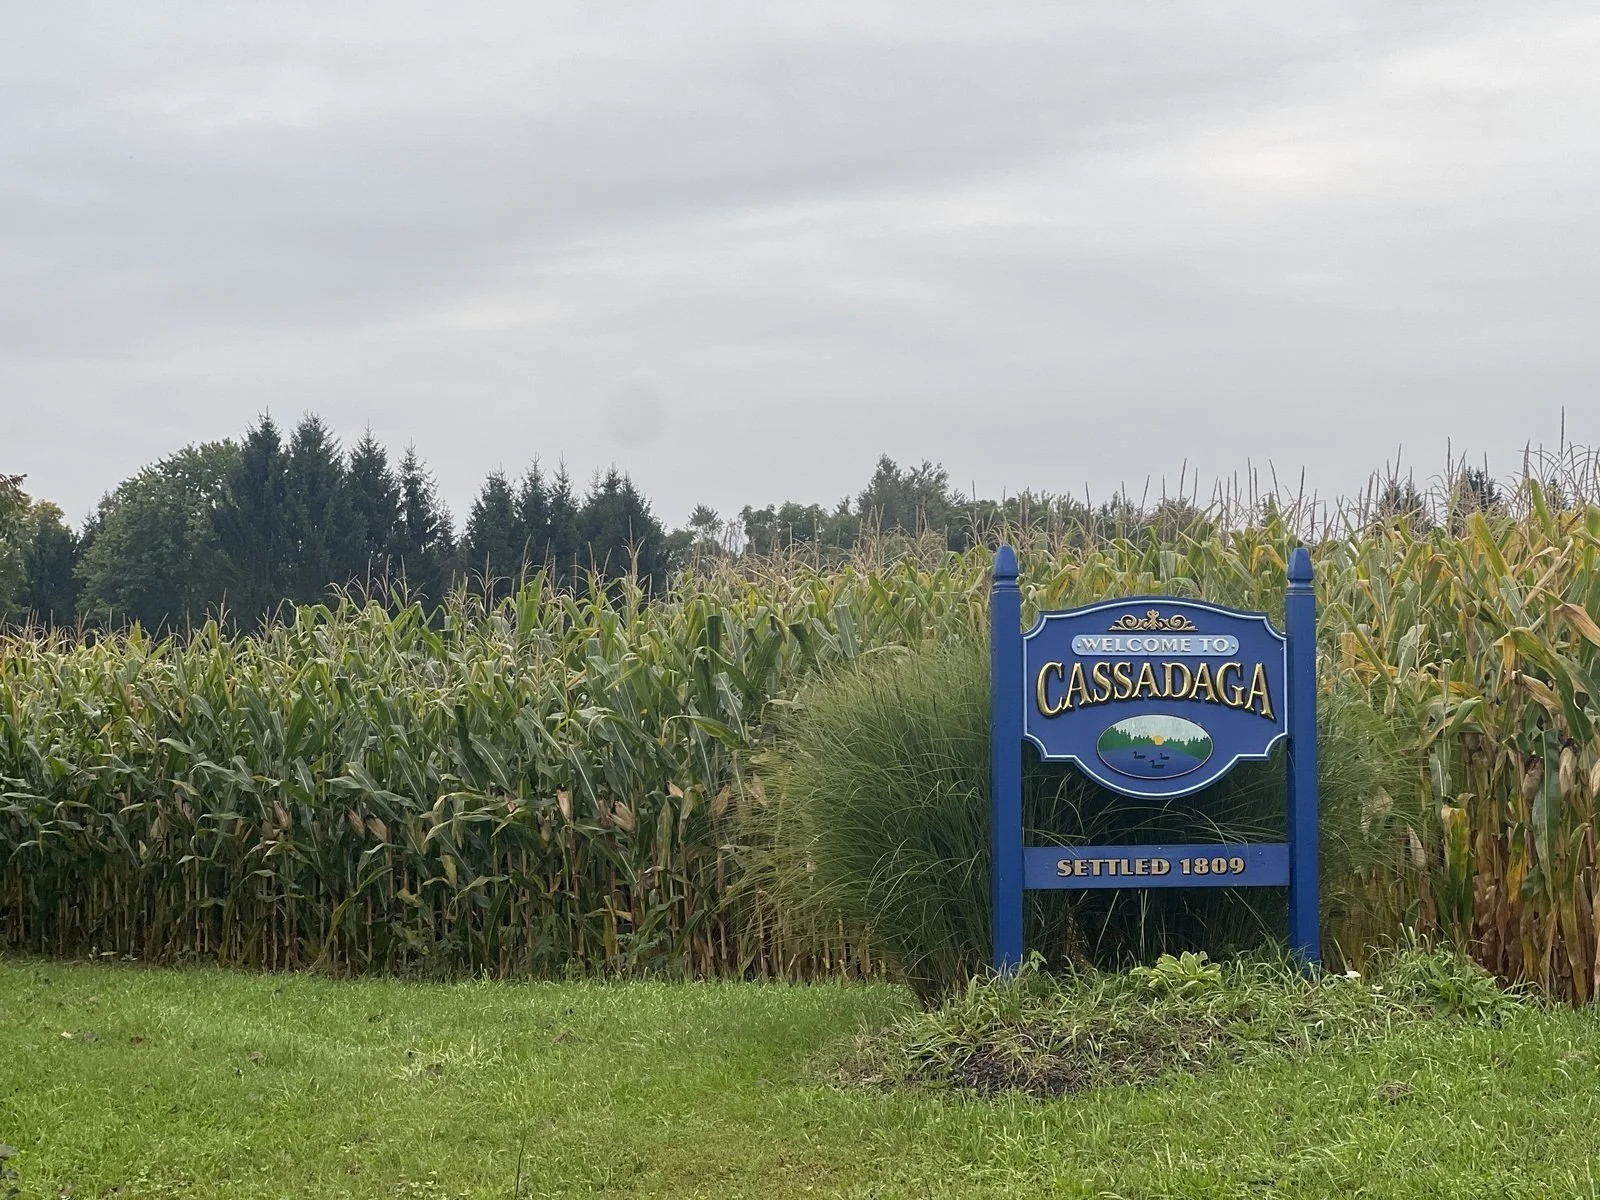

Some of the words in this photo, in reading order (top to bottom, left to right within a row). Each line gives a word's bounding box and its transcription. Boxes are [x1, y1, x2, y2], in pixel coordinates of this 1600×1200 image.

[1079, 637, 1192, 652] WELCOME
[1199, 637, 1230, 652] TO
[1036, 661, 1276, 720] CASSADAGA
[1056, 857, 1171, 877] SETTLED
[1179, 857, 1246, 875] 1809
